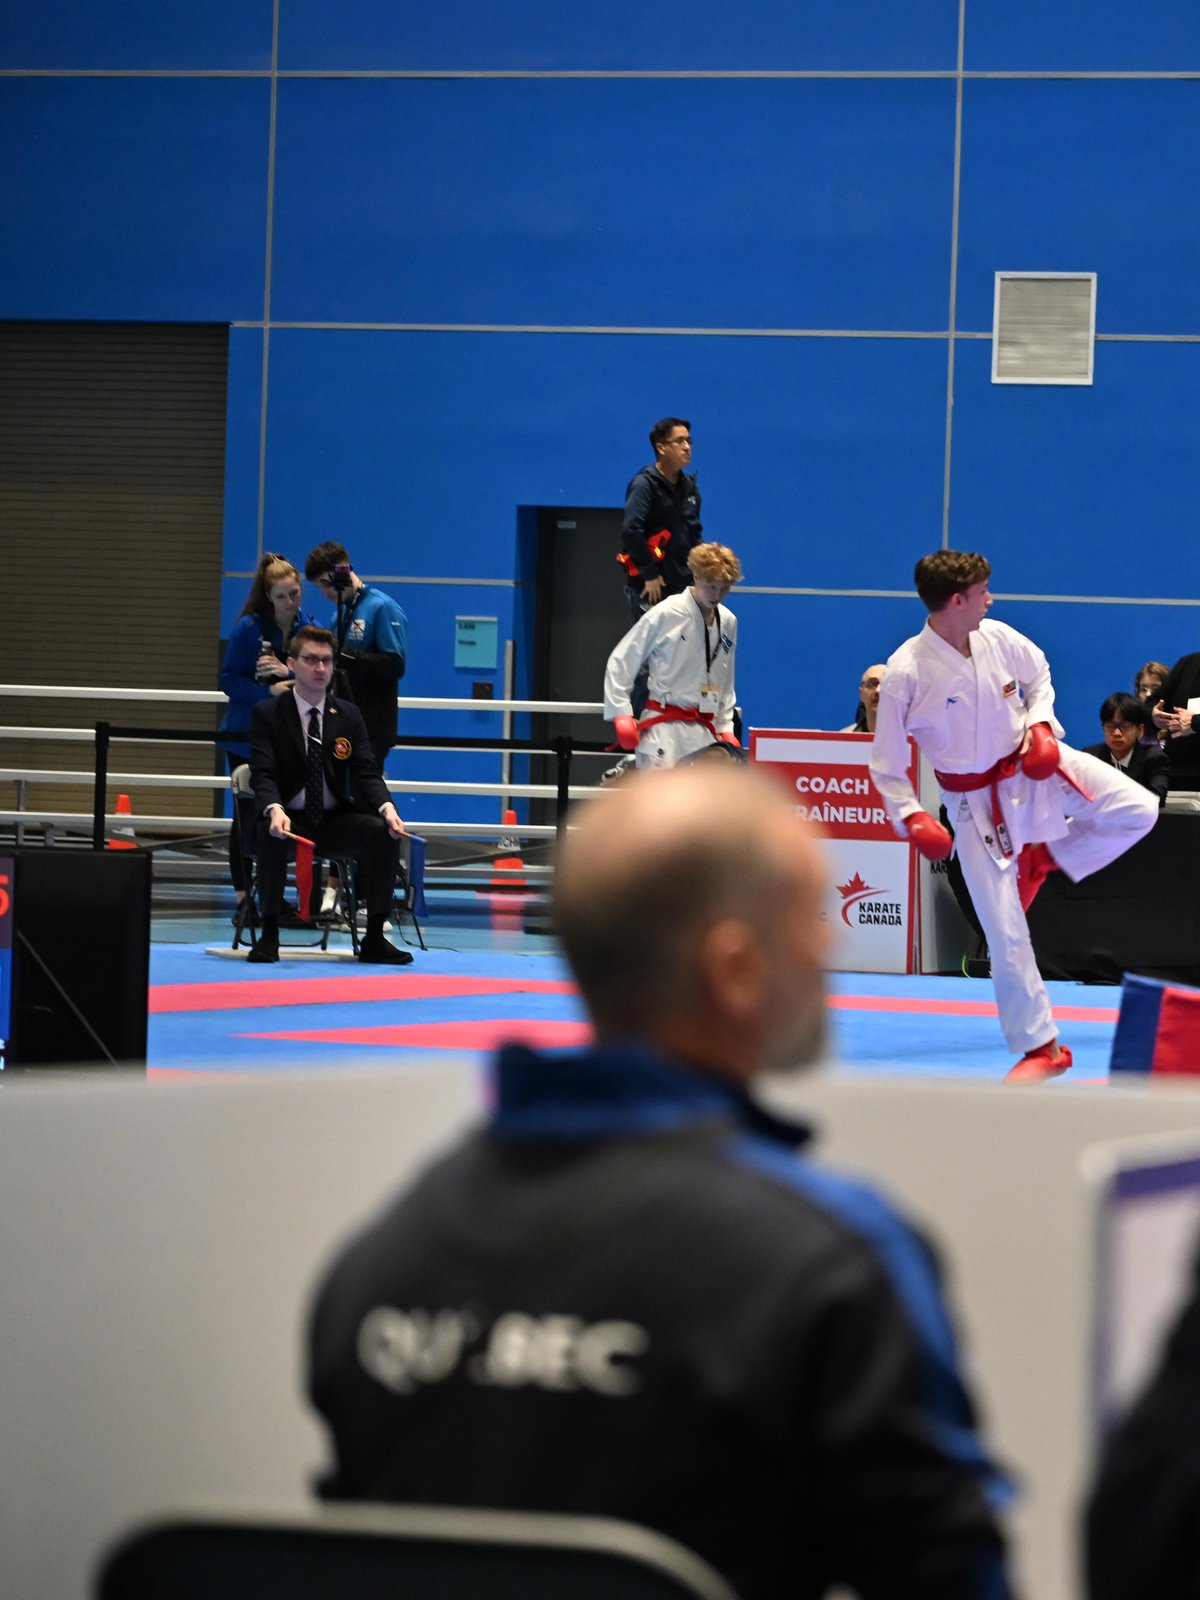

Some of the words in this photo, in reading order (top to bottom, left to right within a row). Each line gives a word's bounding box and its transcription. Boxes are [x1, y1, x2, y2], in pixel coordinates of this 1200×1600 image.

[796, 776, 869, 795] COACH
[859, 902, 902, 914] KARATE
[859, 913, 902, 926] CANADA
